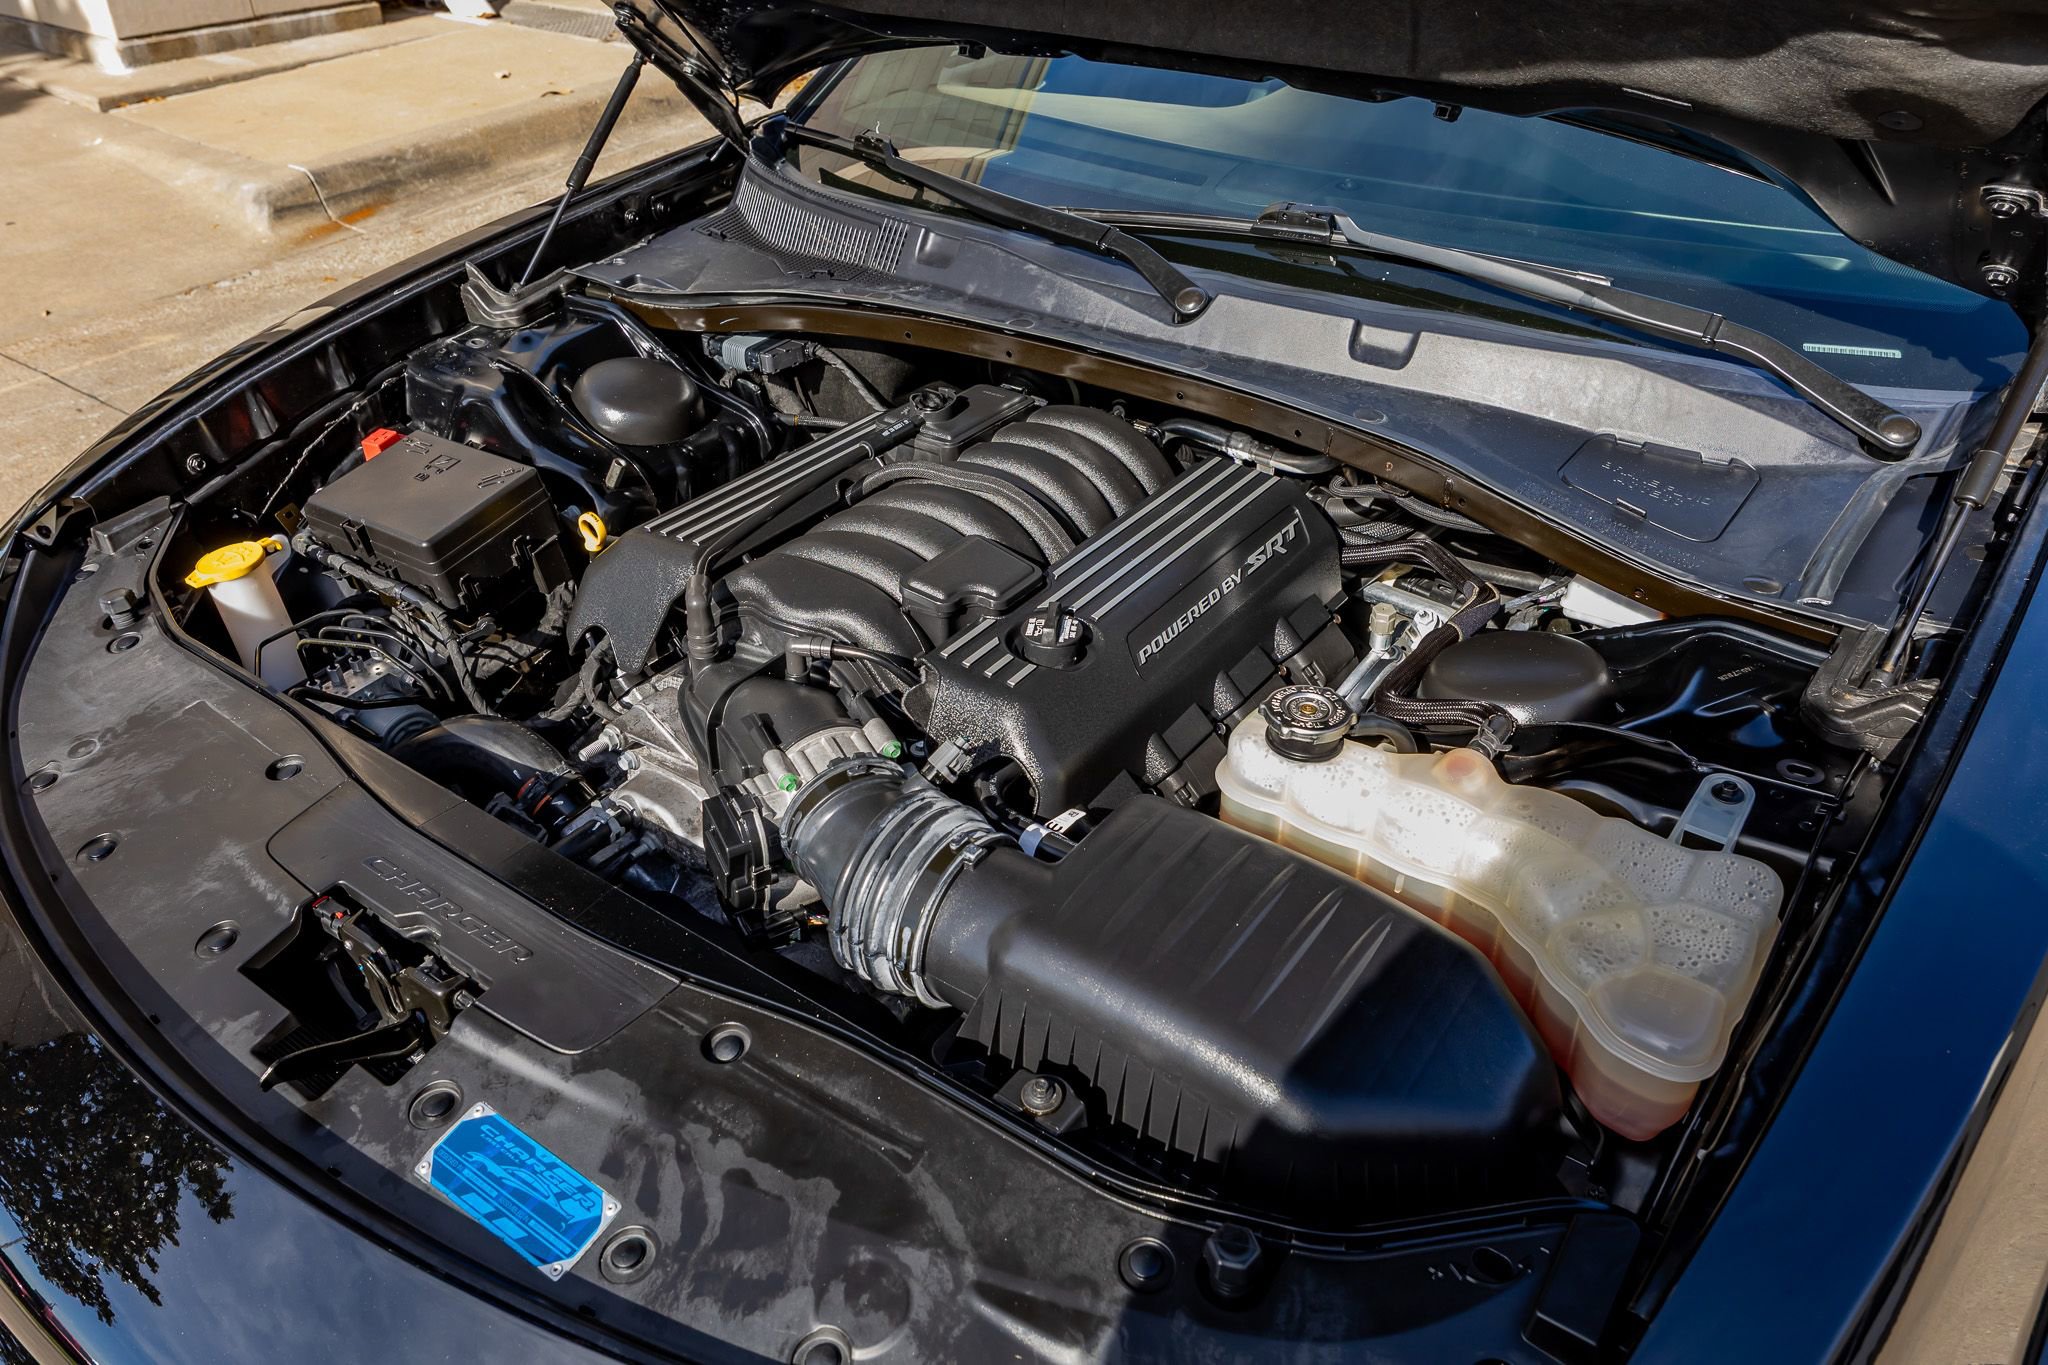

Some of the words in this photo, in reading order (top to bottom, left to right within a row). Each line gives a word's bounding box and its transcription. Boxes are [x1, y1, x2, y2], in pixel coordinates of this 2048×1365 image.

[1138, 587, 1221, 666] POWERED
[1221, 568, 1242, 596] BY
[1245, 517, 1299, 577] SRT
[361, 855, 534, 965] CHARGER
[480, 1124, 597, 1213] CHARGER
